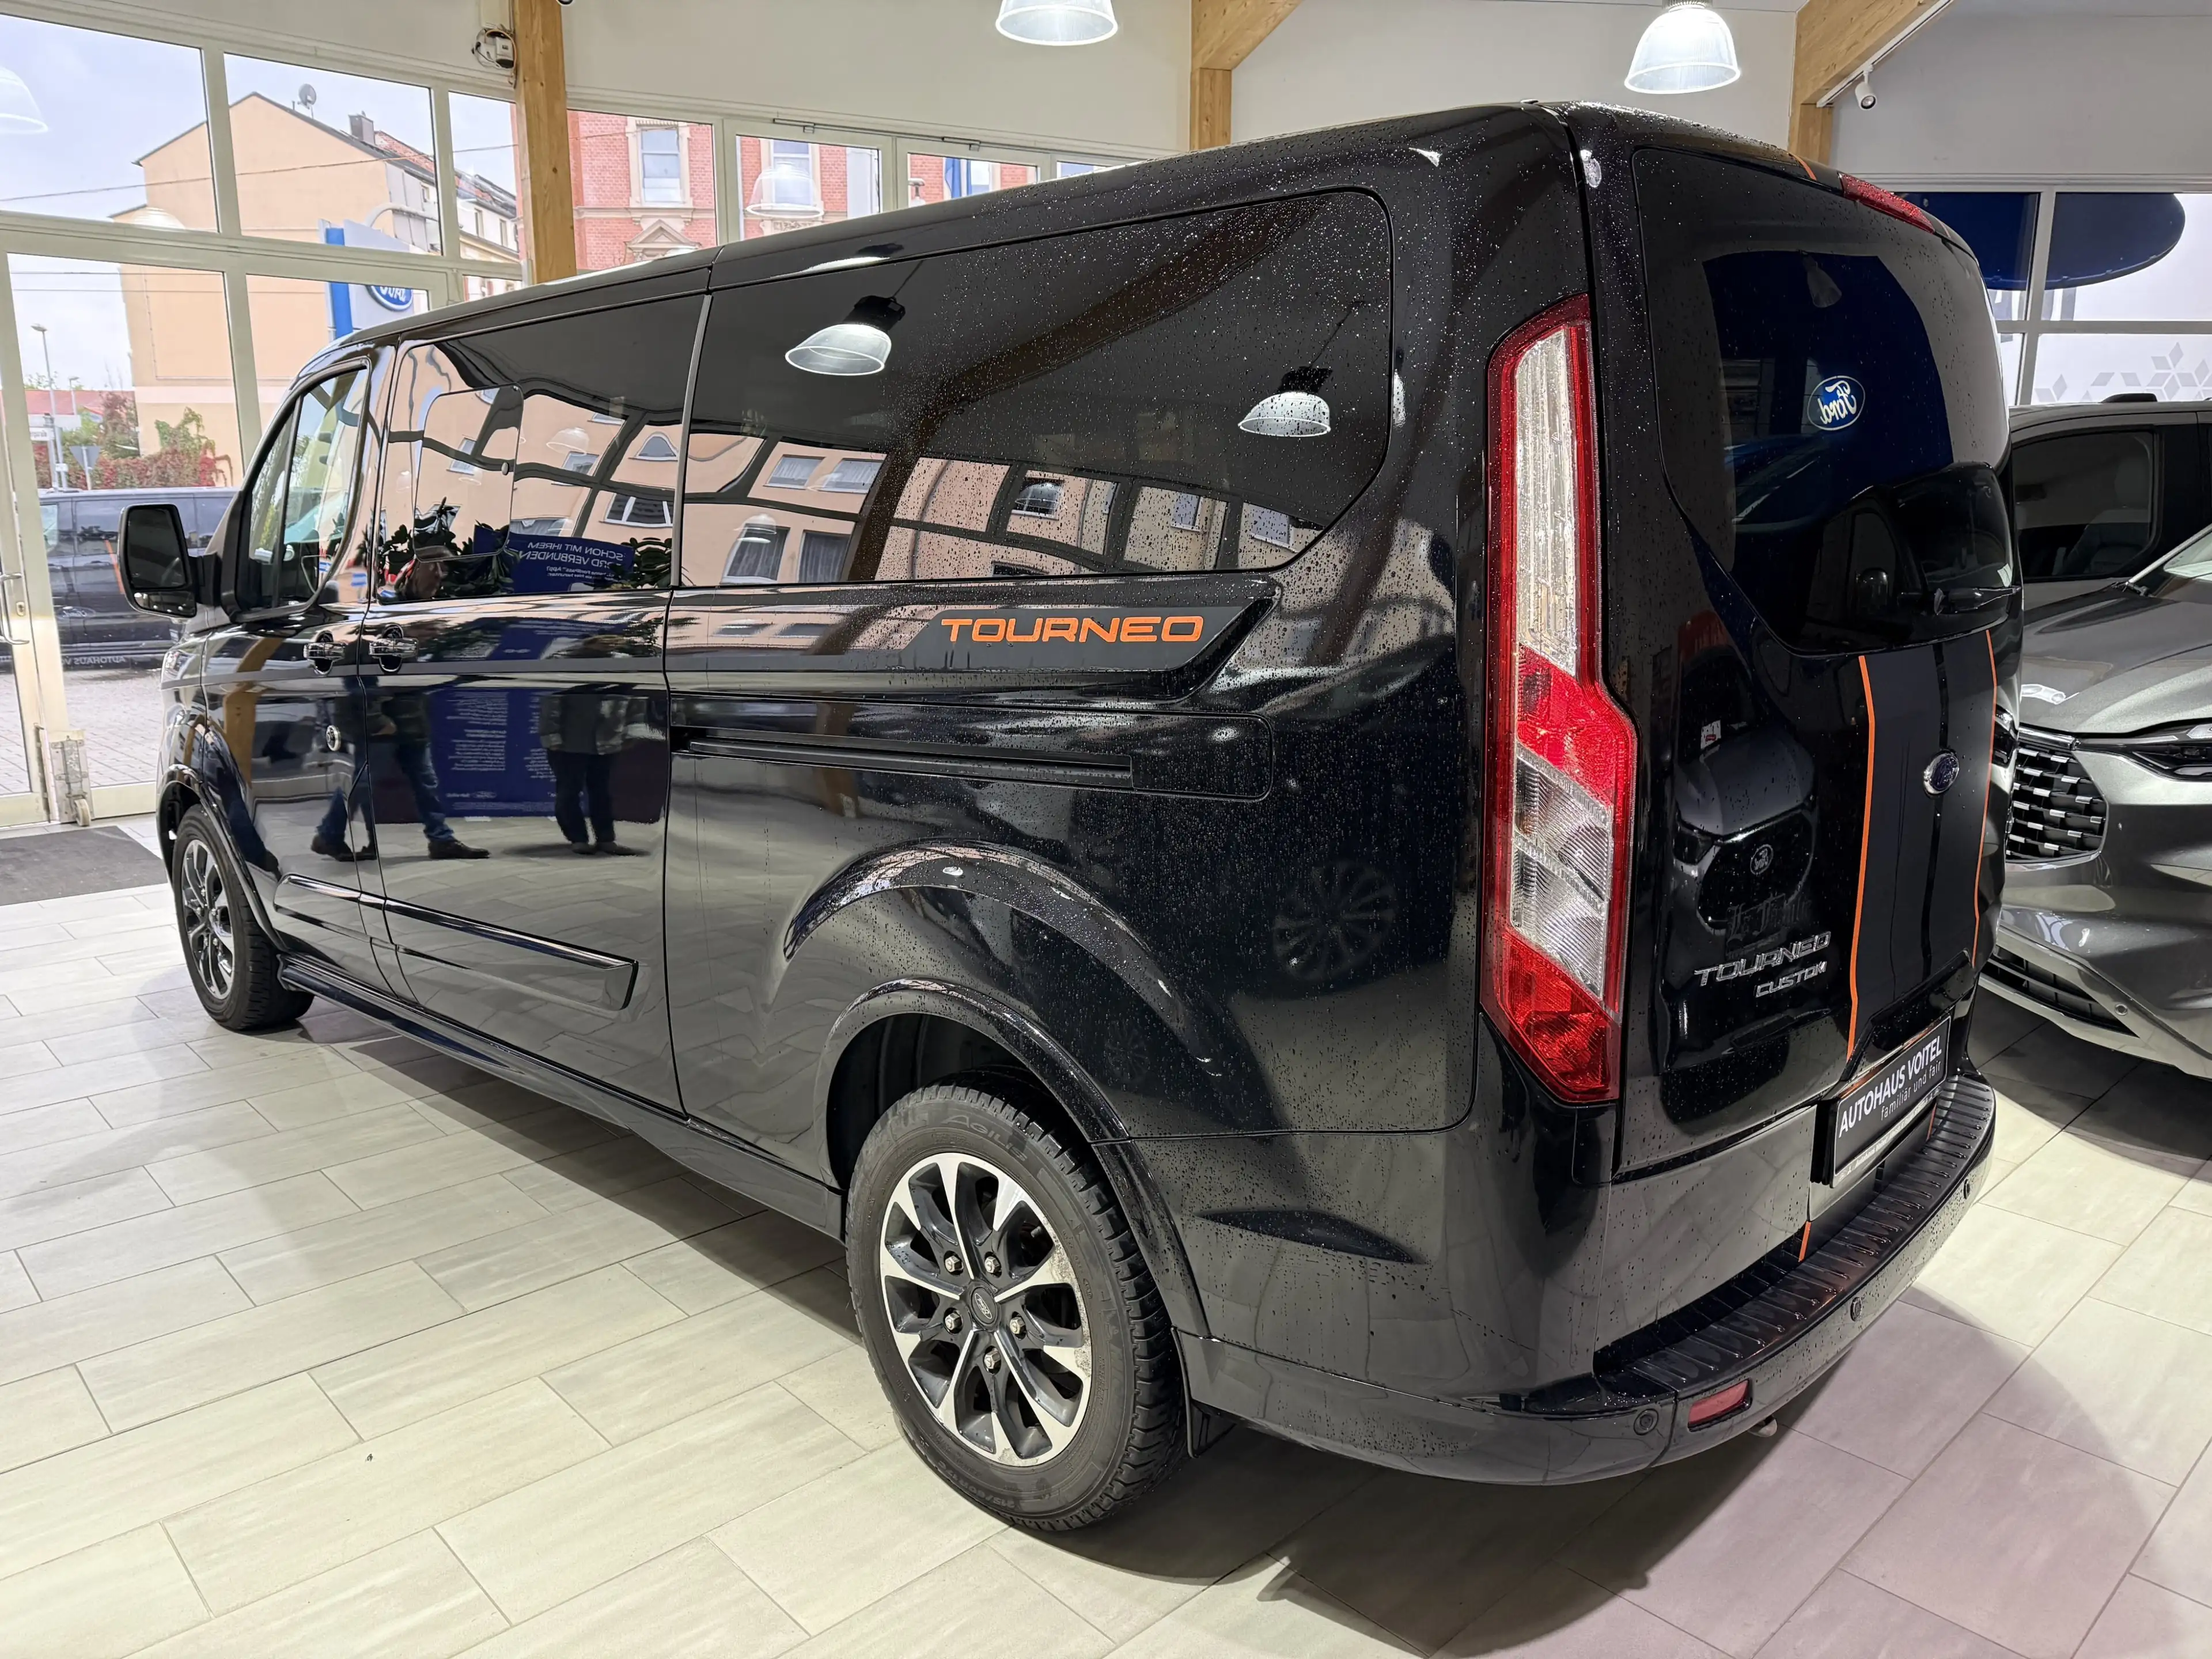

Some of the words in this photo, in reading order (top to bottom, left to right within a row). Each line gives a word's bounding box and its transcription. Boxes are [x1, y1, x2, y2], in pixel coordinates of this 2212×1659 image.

[941, 616, 1204, 642] TOURNEO
[1694, 931, 1831, 987] TOURNEO
[1754, 961, 1827, 998] CUSTOM
[1839, 1065, 1906, 1138] AUTOHAUS
[1908, 1036, 1942, 1080] VOITEL
[1881, 1087, 1911, 1121] familiär
[1914, 1070, 1926, 1092] und
[1929, 1060, 1942, 1080] fair
